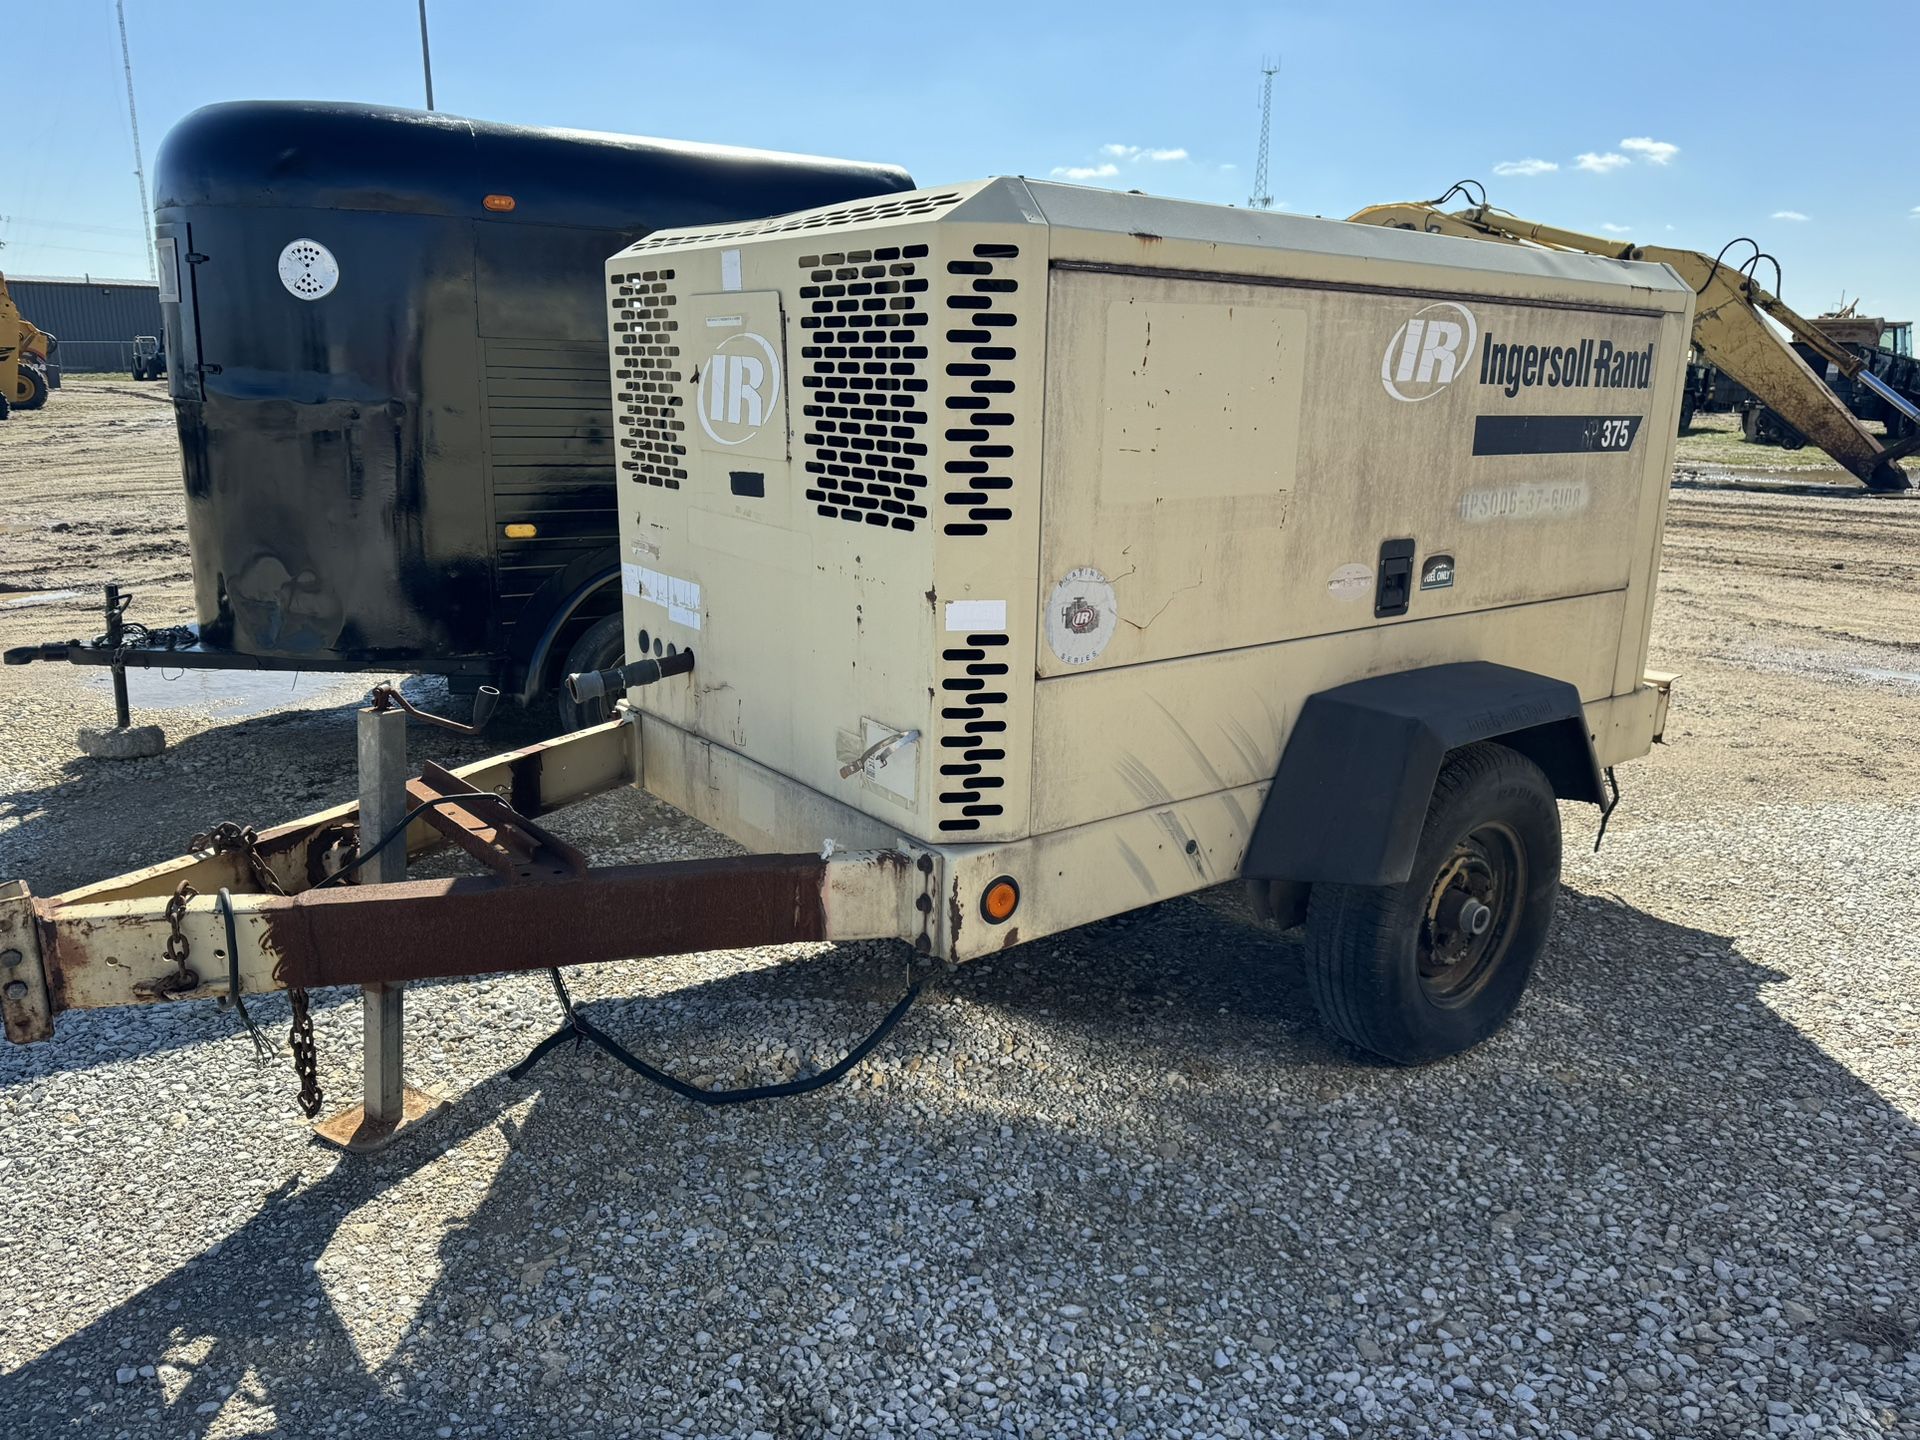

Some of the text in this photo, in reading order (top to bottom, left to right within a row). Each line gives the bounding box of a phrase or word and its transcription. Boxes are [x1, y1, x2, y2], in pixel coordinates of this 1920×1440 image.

[1396, 318, 1462, 383] IR
[710, 354, 764, 427] IR
[1600, 420, 1630, 448] 375
[1437, 570, 1451, 581] ONLY
[1075, 612, 1090, 625] IR
[1060, 650, 1098, 664] SERIES
